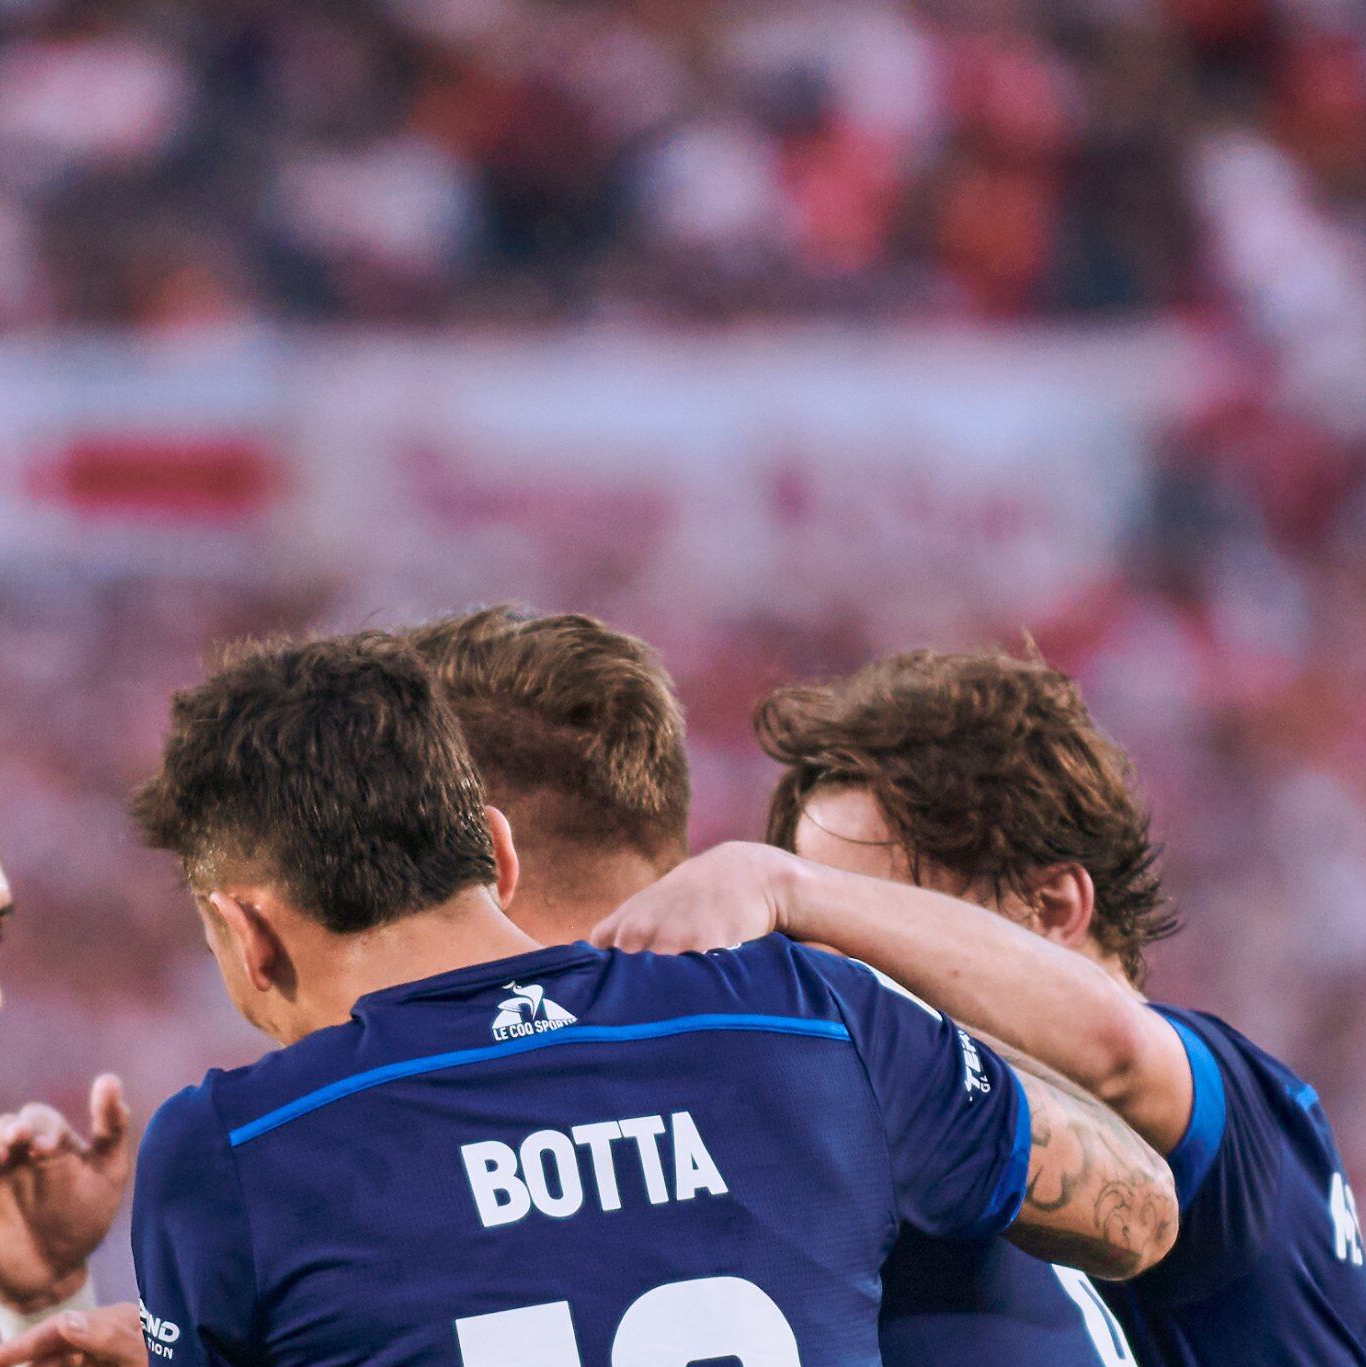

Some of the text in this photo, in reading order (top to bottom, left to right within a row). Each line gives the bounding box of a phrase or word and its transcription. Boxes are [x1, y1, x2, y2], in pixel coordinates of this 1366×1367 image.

[492, 1027, 509, 1041] LE
[509, 1022, 534, 1038] COQ
[461, 1111, 728, 1228] BOTTA
